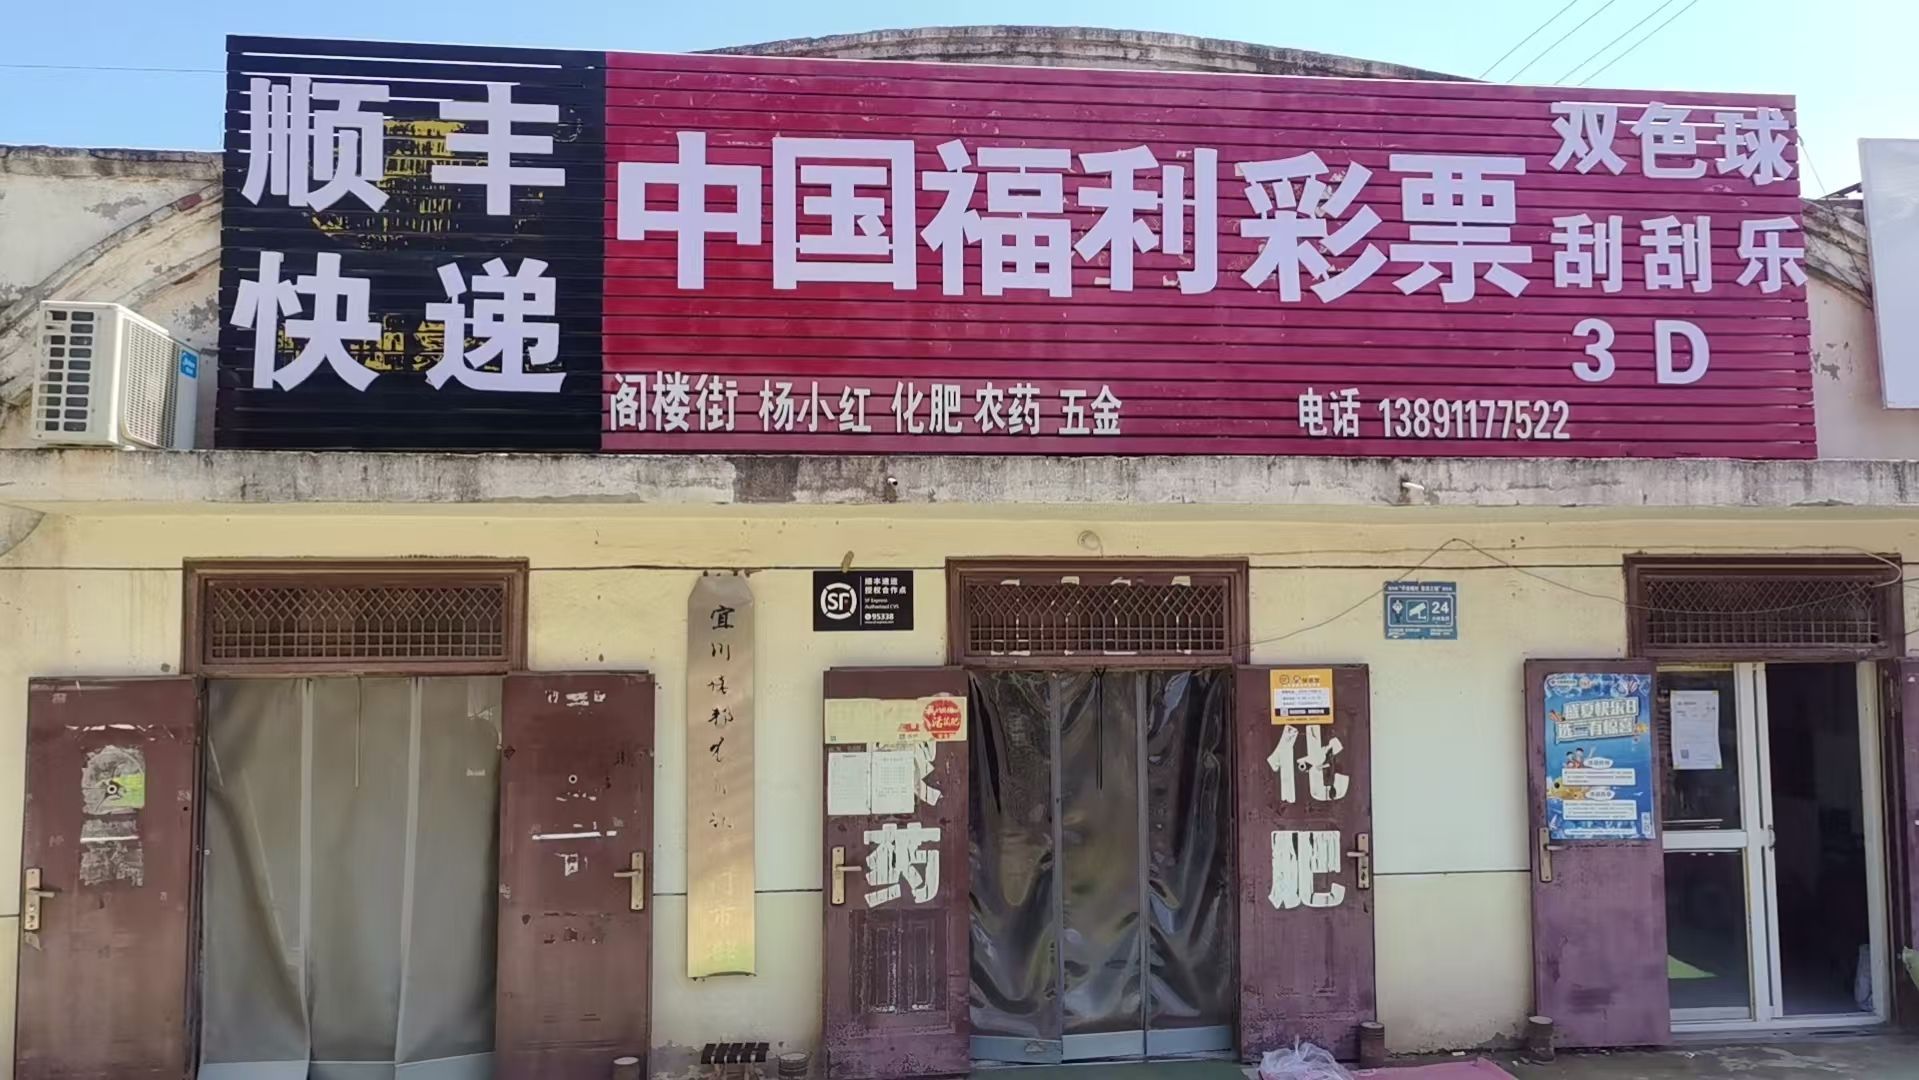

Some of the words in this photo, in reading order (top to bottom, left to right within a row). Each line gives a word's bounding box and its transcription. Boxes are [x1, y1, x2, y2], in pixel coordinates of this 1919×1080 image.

[242, 74, 566, 216] 顺丰
[1550, 100, 1797, 186] 双色球
[617, 131, 1533, 304] 中国福利彩票
[1550, 213, 1808, 293] 刮刮乐
[230, 250, 567, 393] 快递
[609, 371, 739, 432] 阁楼街
[758, 378, 873, 435] 杨小红
[891, 381, 964, 435] 化肥
[973, 381, 1042, 436] 农药
[1057, 384, 1123, 437] 五金
[1298, 386, 1361, 438] 电话
[1377, 397, 1571, 440] 13891177522
[871, 612, 895, 621] 95338
[1431, 601, 1449, 614] 24
